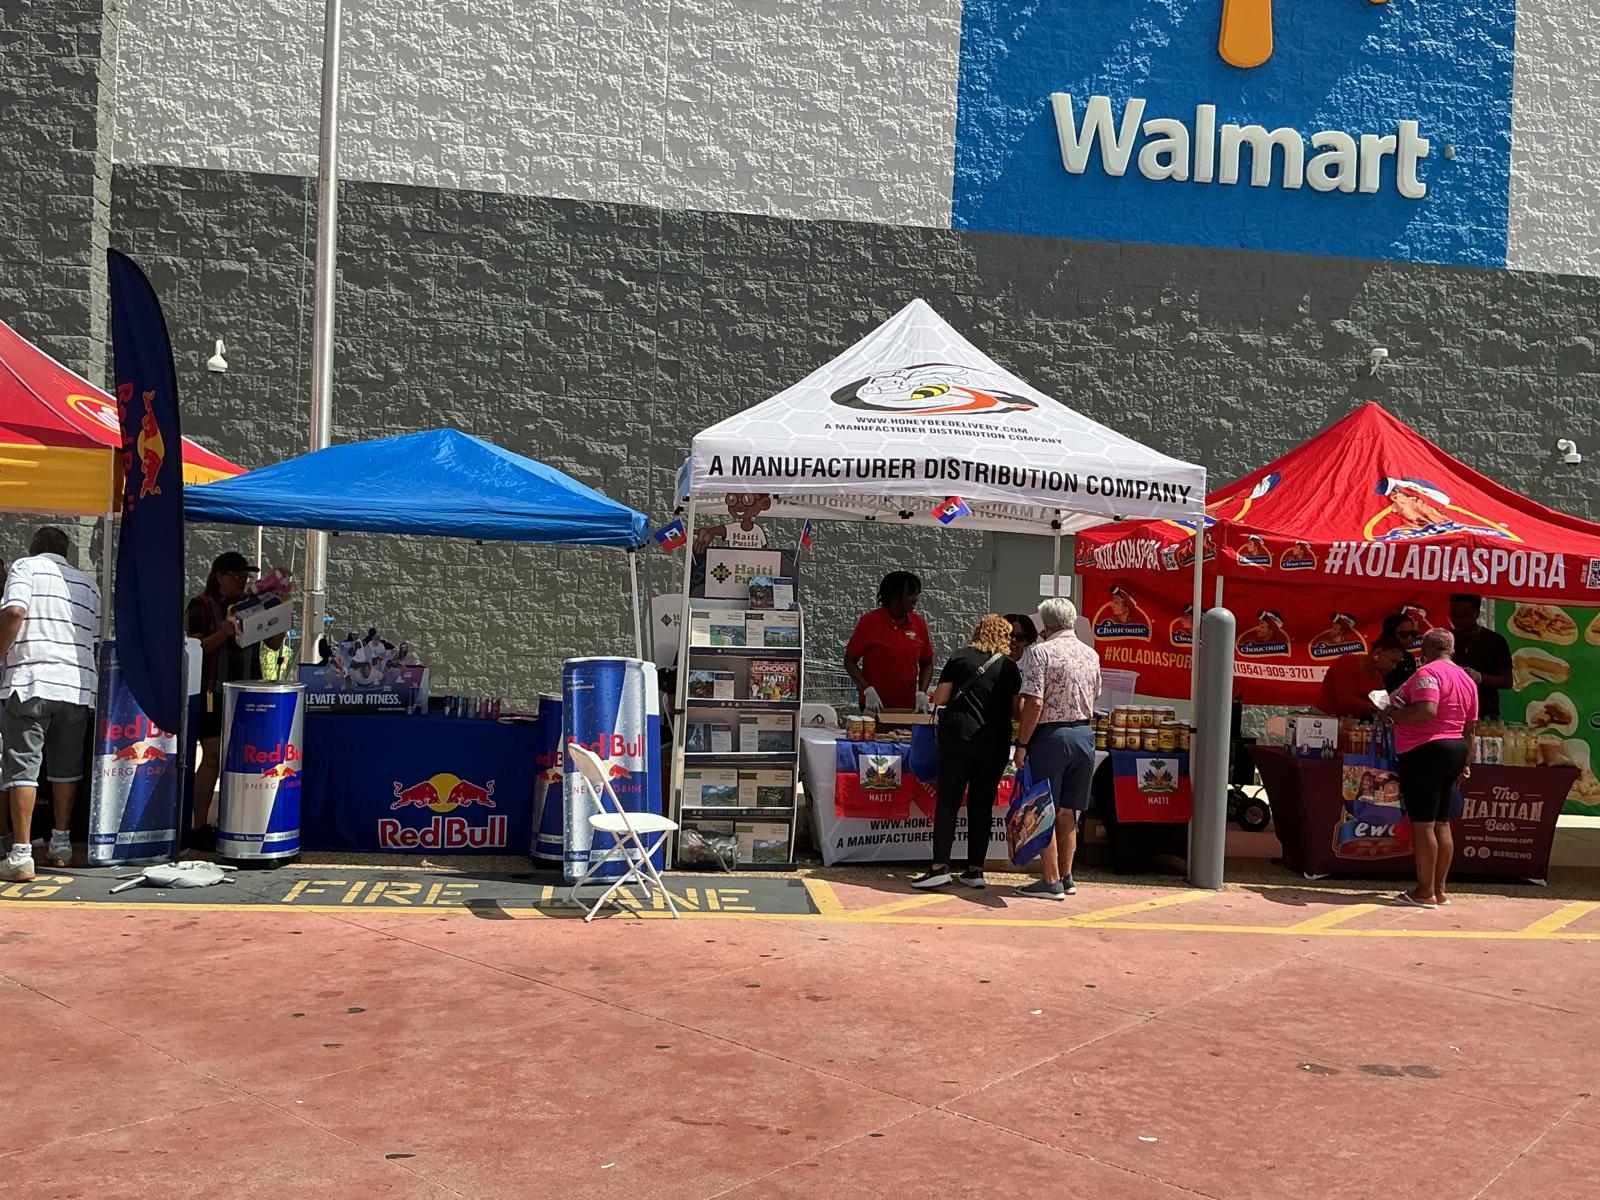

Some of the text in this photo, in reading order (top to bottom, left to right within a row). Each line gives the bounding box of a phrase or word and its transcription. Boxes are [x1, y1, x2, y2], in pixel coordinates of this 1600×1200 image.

[1050, 92, 1430, 199] Walmart
[856, 416, 1028, 434] WWW.HONEYBEEDELIVERY.COM
[835, 424, 926, 434] MANUFACTURER
[929, 427, 1005, 440] DISTRIBUTION
[1008, 434, 1063, 445] COMPANY
[708, 455, 1192, 505] A MANUFACTURER DISTRIBUTION COMPANY
[732, 532, 759, 541] Haiti
[734, 563, 773, 575] Haiti
[1325, 541, 1566, 589] #KOLADIASPORA
[1096, 626, 1146, 636] Choucoune
[1240, 643, 1286, 654] Choucoune
[1313, 643, 1362, 655] Choucoune
[1104, 646, 1193, 670] #KOLADIASPOR
[754, 664, 795, 673] MONOPOLY
[305, 693, 402, 705] LEVATE YOUR FITNESS.
[243, 743, 282, 764] Red
[610, 734, 645, 758] Bull
[869, 793, 892, 802] HAITI
[1148, 796, 1169, 805] HAITI
[1492, 786, 1520, 801] The
[1461, 798, 1544, 822] HAITIAN
[378, 815, 508, 849] Red Bull
[1485, 819, 1517, 831] Beer
[836, 837, 844, 849] A
[281, 879, 479, 906] FIRE
[540, 885, 757, 912] LANE
